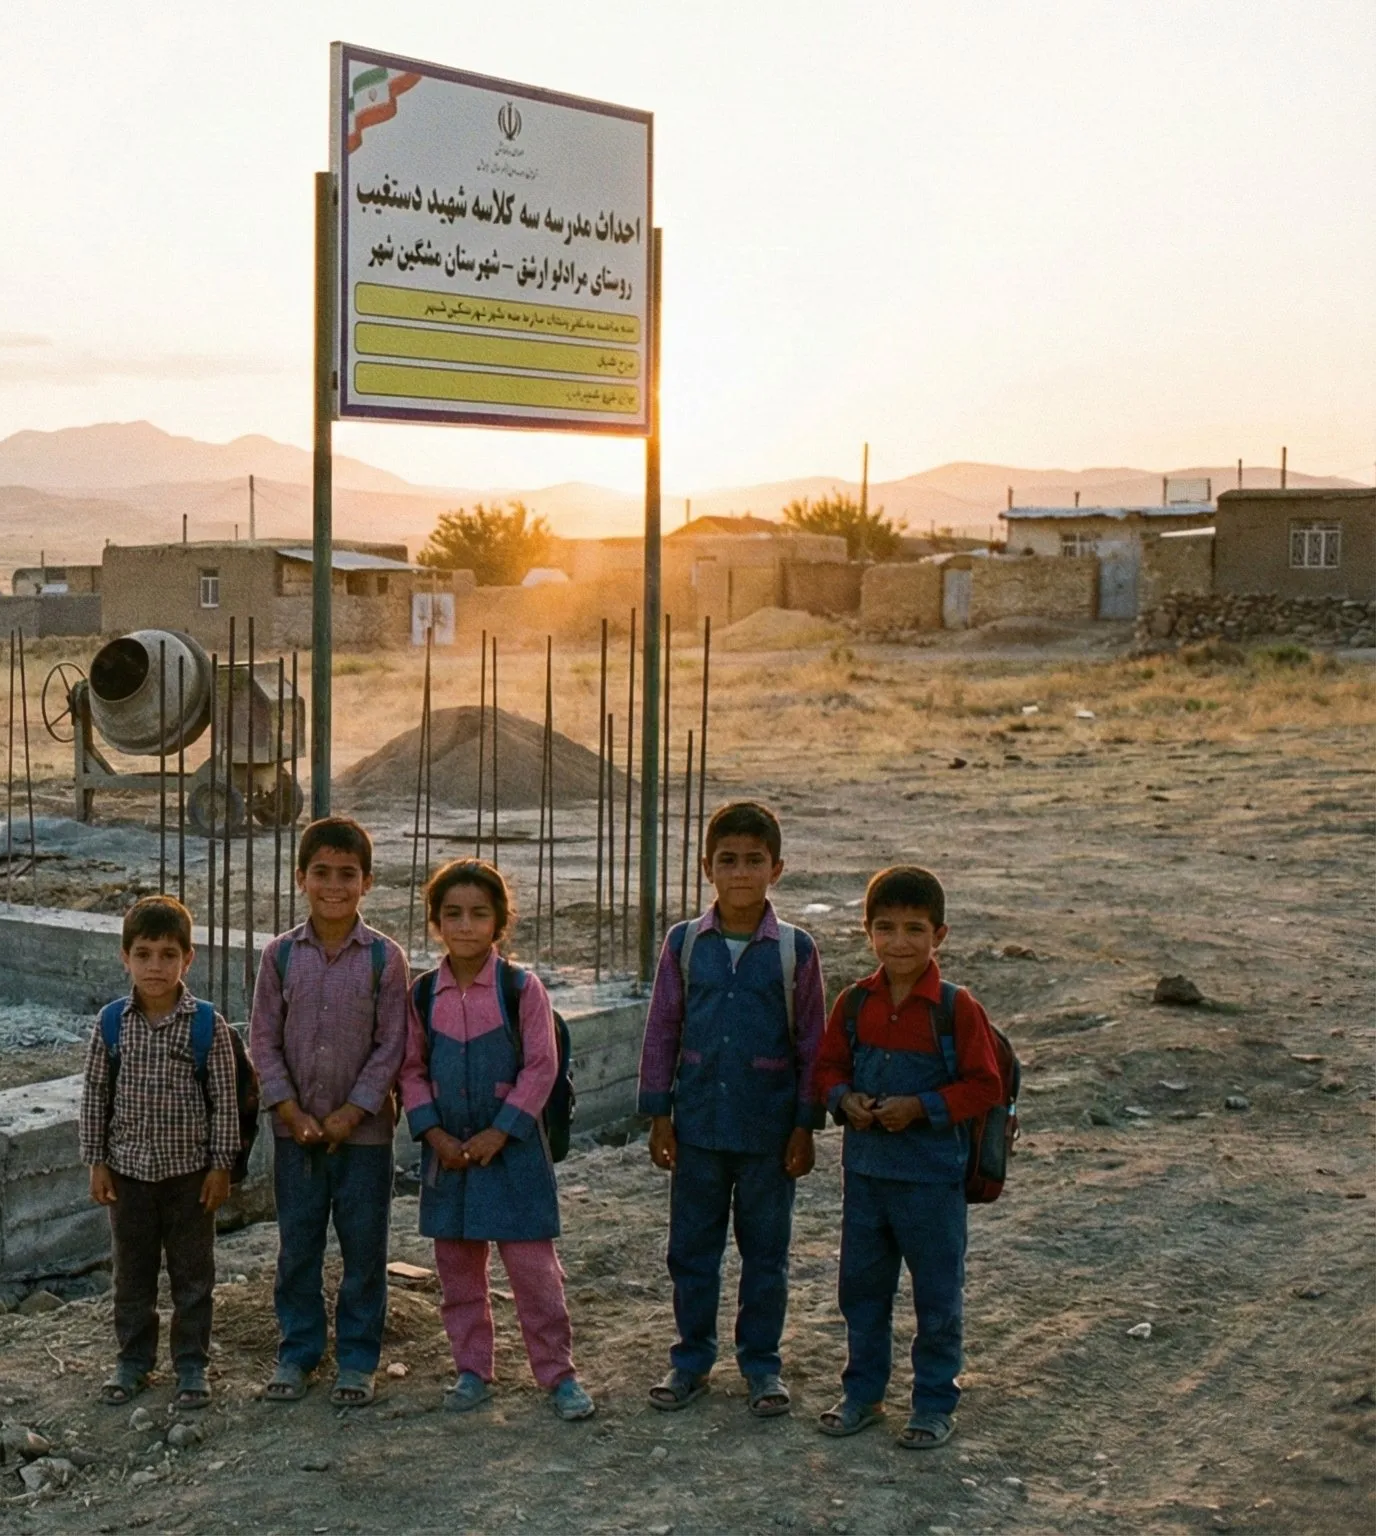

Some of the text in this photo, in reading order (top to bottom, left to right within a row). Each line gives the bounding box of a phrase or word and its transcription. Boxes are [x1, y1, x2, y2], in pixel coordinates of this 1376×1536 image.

[355, 173, 641, 246] احداث مدرسه سه کلاسه شهید دستغیب
[367, 233, 395, 268] شهر
[396, 238, 442, 272] مشگین
[444, 243, 501, 282] شهرستان
[516, 254, 549, 289] ارشق
[550, 258, 588, 295] مرادلو
[590, 265, 633, 301] روستای
